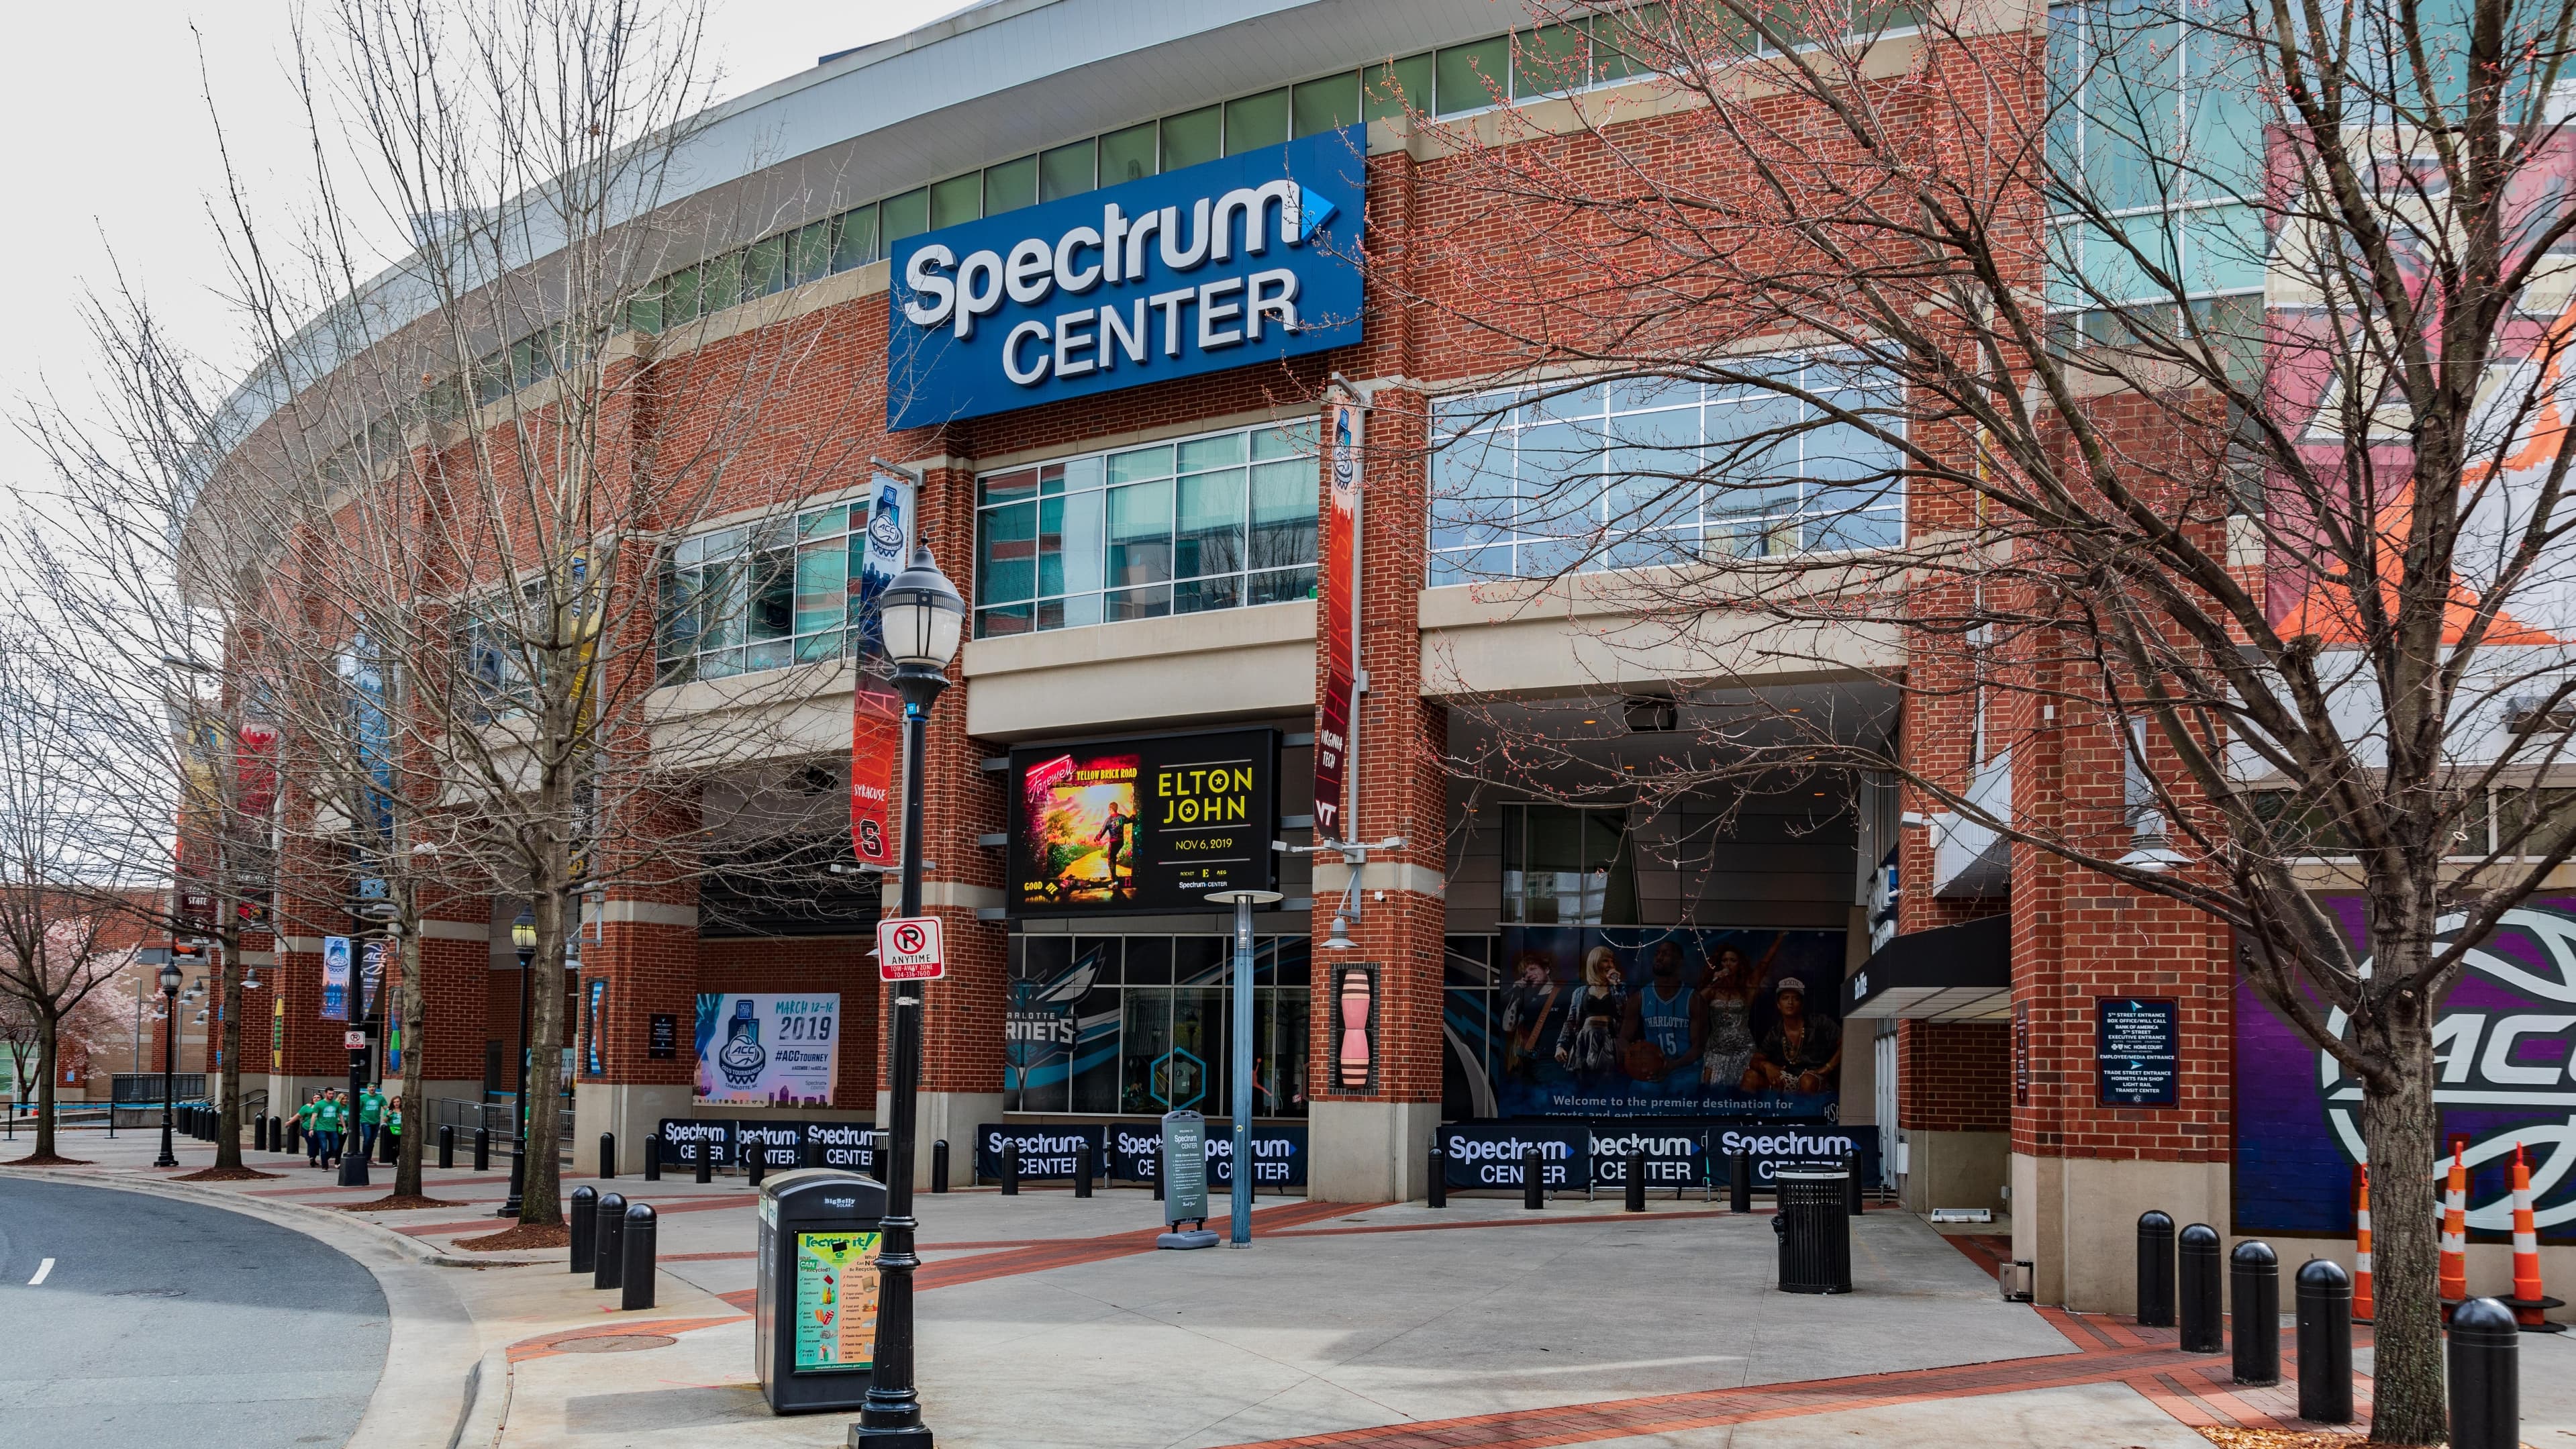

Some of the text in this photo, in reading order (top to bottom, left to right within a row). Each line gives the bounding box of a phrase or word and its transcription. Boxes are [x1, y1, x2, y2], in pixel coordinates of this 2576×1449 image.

[905, 179, 1302, 341] Spectrum
[1003, 268, 1300, 387] CENTER
[879, 524, 895, 534] ACC
[1321, 729, 1343, 752] VIRGINIA
[1323, 750, 1336, 769] TECH
[1028, 759, 1077, 803] Farewell
[1077, 768, 1138, 781] YELLOW BRICK ROAD
[1158, 767, 1252, 797] ELTON
[854, 784, 885, 802] SYRACUSE
[1162, 795, 1246, 823] JOHN
[1316, 799, 1336, 827] VT
[859, 818, 884, 857] S
[1176, 838, 1232, 851] NOV 6, 2019
[1024, 881, 1058, 895] GOOD BYE
[188, 897, 208, 905] STATE
[363, 952, 388, 960] ACC
[892, 954, 931, 964] ANYTIME
[775, 1001, 834, 1014] MARCH 12-16
[1007, 1011, 1056, 1020] ARLOTTE
[779, 1017, 832, 1040] 2019
[1006, 1017, 1074, 1044] RNETS
[732, 1046, 756, 1054] ACC
[1658, 1033, 1677, 1055] 15
[2433, 1014, 2576, 1085] AC
[721, 1064, 763, 1075] 2019 TOURNAMENT
[1553, 1095, 1793, 1109] Welcome to the premier destination for
[665, 1123, 724, 1145] Spectrum
[740, 1128, 795, 1145] pectrum
[1175, 1134, 1197, 1144] Spectrum
[681, 1145, 723, 1160] CEER
[746, 1150, 794, 1164] CNTER
[1218, 1162, 1289, 1179] CTER
[1481, 1165, 1566, 1183] CENER
[1600, 1162, 1691, 1179] CETER
